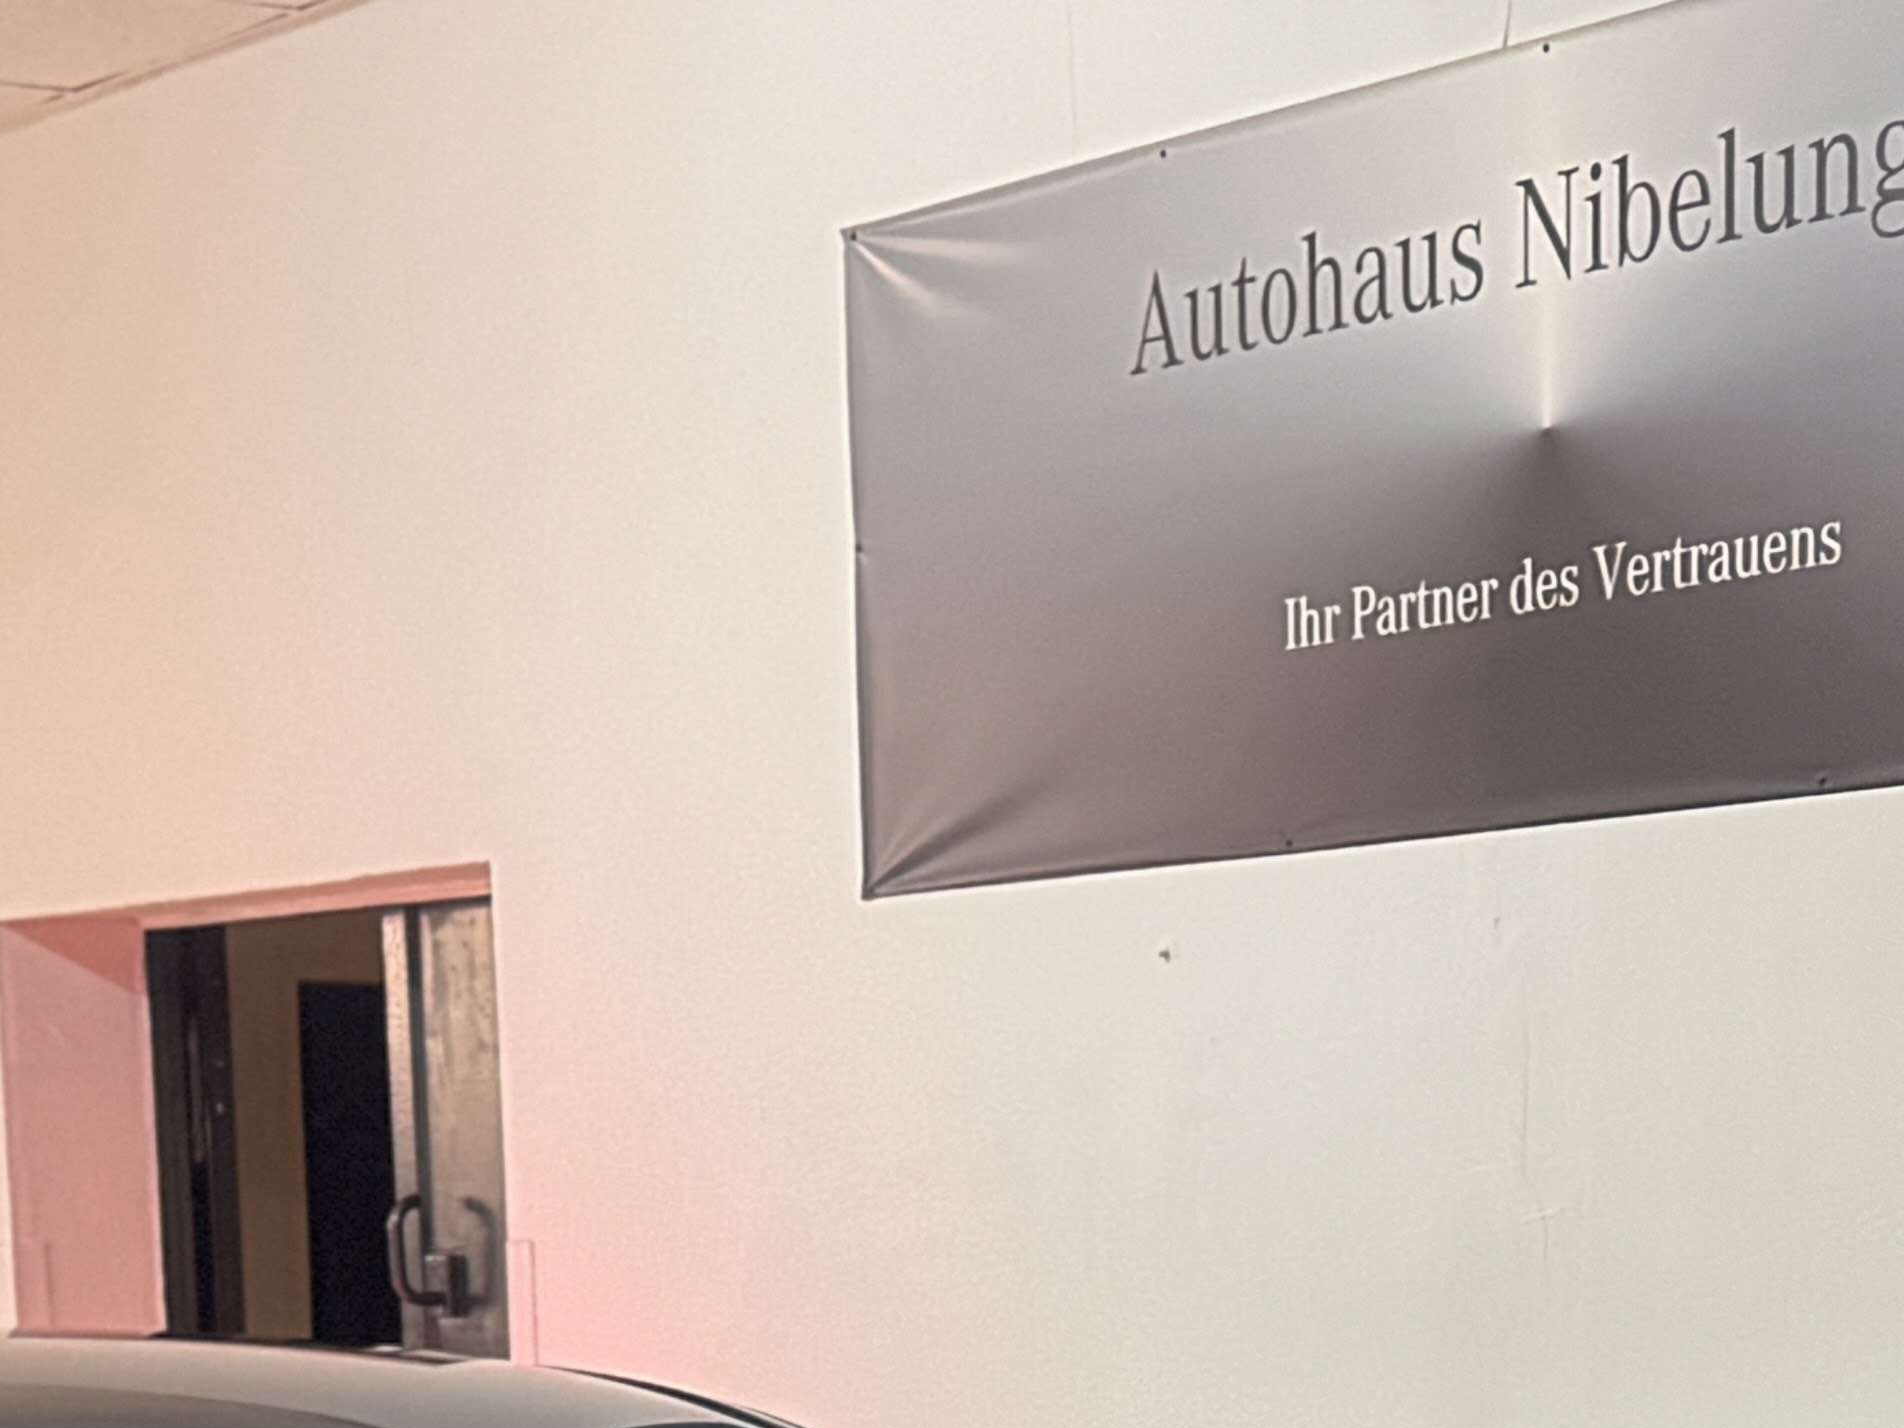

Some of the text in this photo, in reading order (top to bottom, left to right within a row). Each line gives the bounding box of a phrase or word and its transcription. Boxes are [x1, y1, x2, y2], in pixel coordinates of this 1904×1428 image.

[1130, 219, 1484, 376] Autohaus
[1284, 520, 1842, 650] Ihr Partner des Vertrauens
